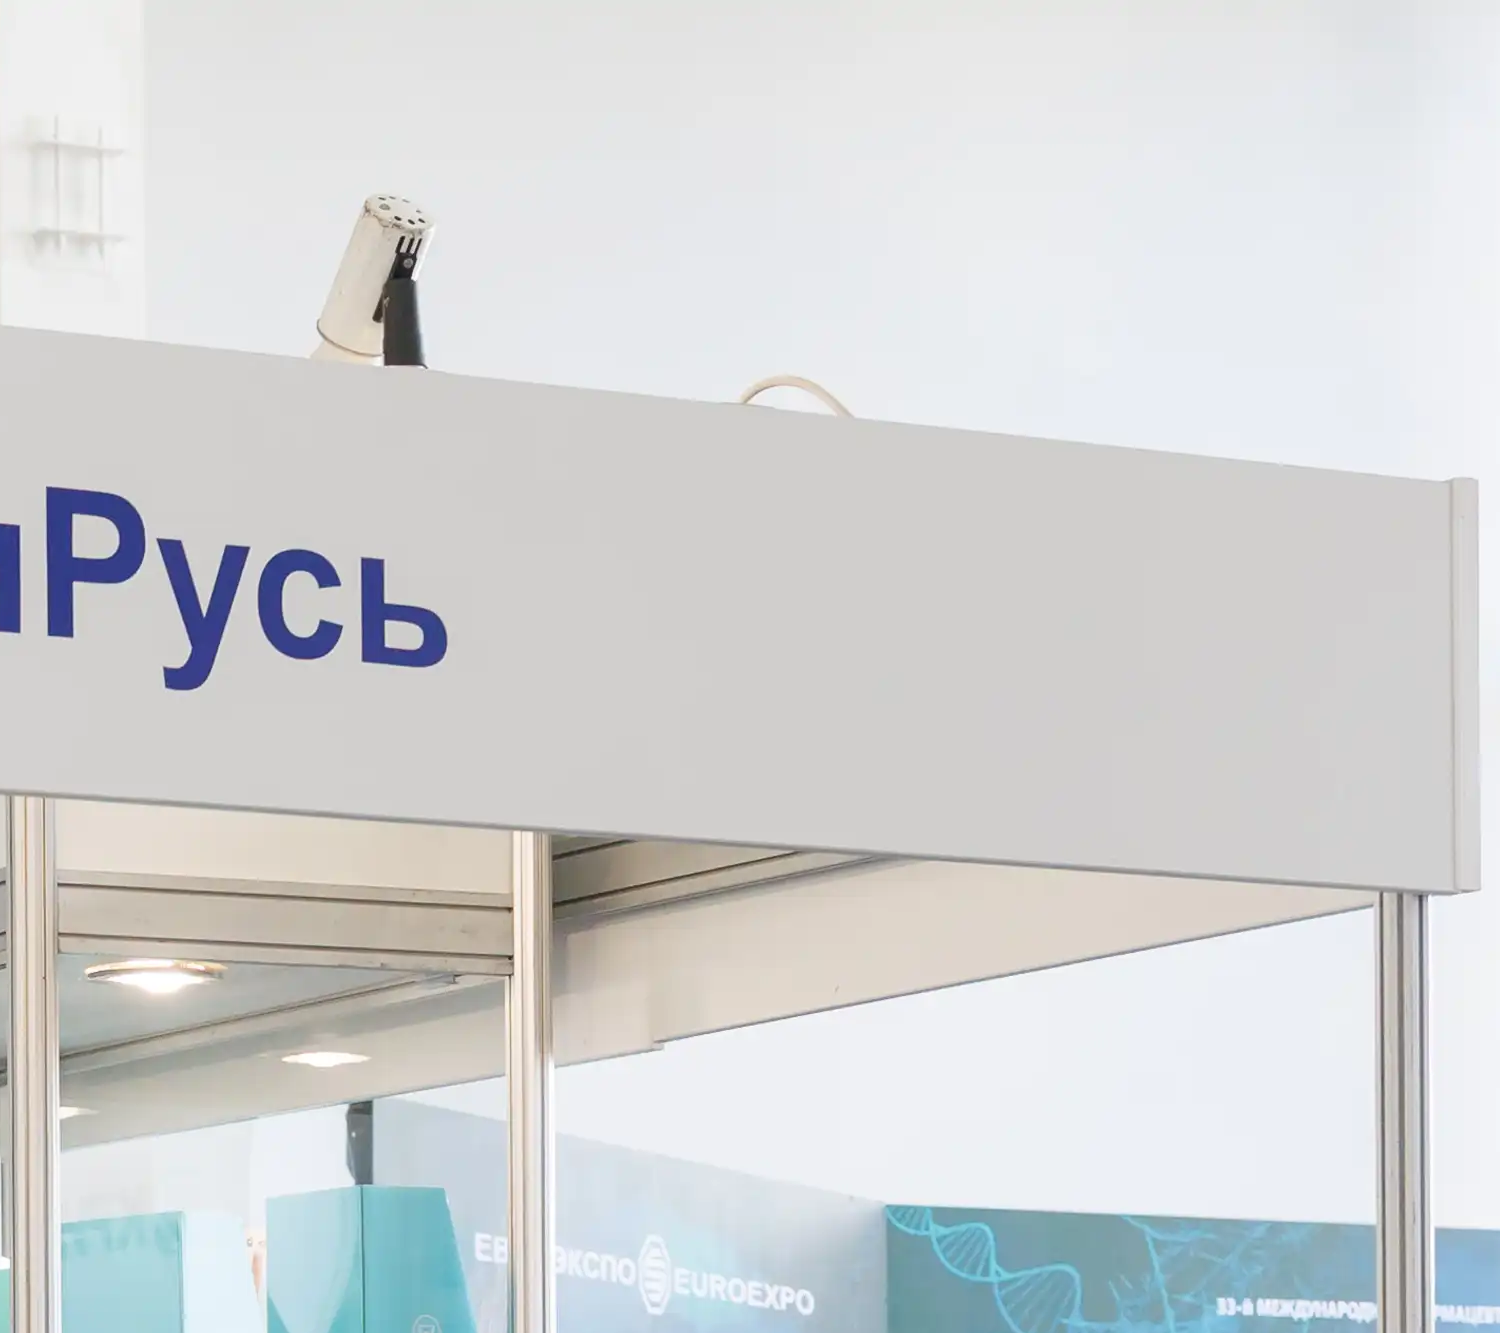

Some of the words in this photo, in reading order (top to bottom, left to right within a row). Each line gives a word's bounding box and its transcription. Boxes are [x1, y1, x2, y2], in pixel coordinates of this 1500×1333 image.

[474, 1232, 637, 1286] ЕВЭКСПО
[675, 1267, 816, 1316] EUROEXPO
[1256, 1298, 1378, 1323] МЕЖДУНАРОД
